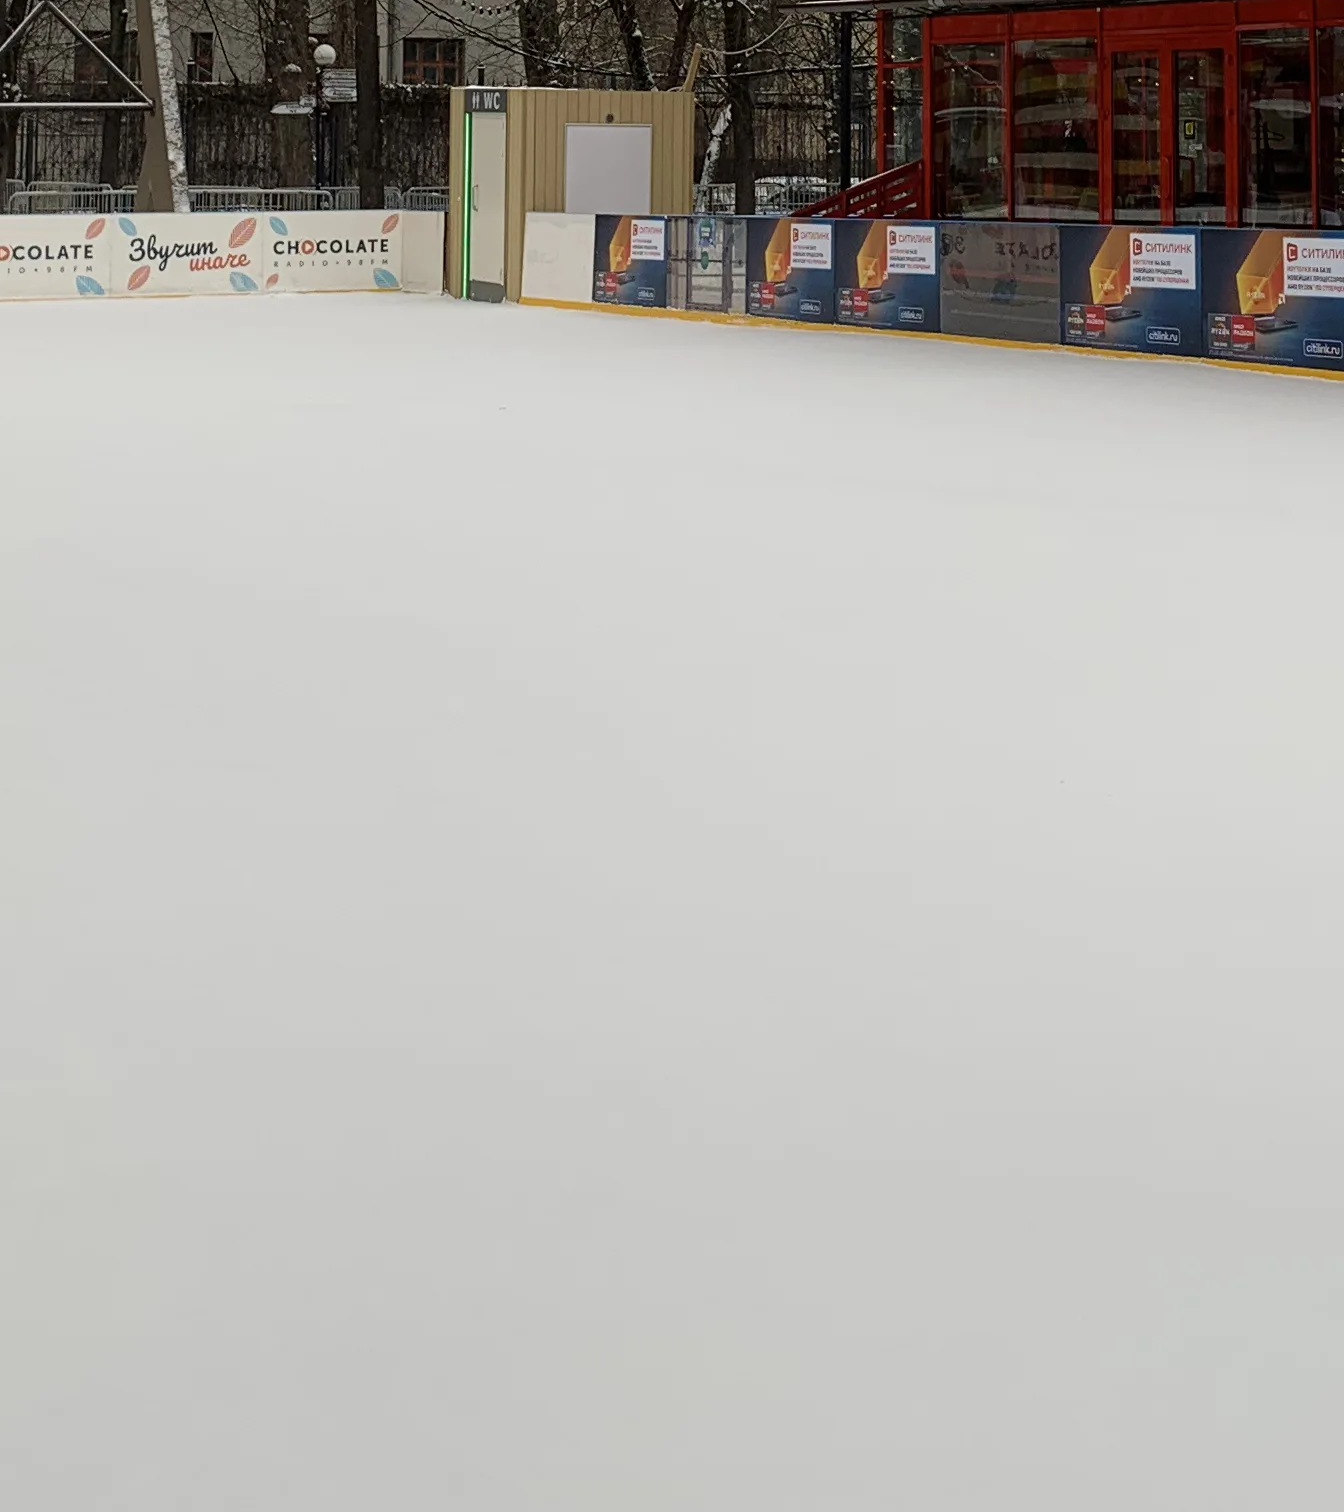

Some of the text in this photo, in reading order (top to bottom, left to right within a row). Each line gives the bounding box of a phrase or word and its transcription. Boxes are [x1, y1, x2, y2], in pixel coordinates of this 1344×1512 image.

[482, 91, 501, 110] WC
[129, 234, 218, 271] Звучит
[273, 239, 389, 255] CHOCOLATE
[1145, 243, 1193, 254] СИТИЛИНК
[189, 253, 251, 271] иначе
[1306, 343, 1340, 355] citilink.ru
